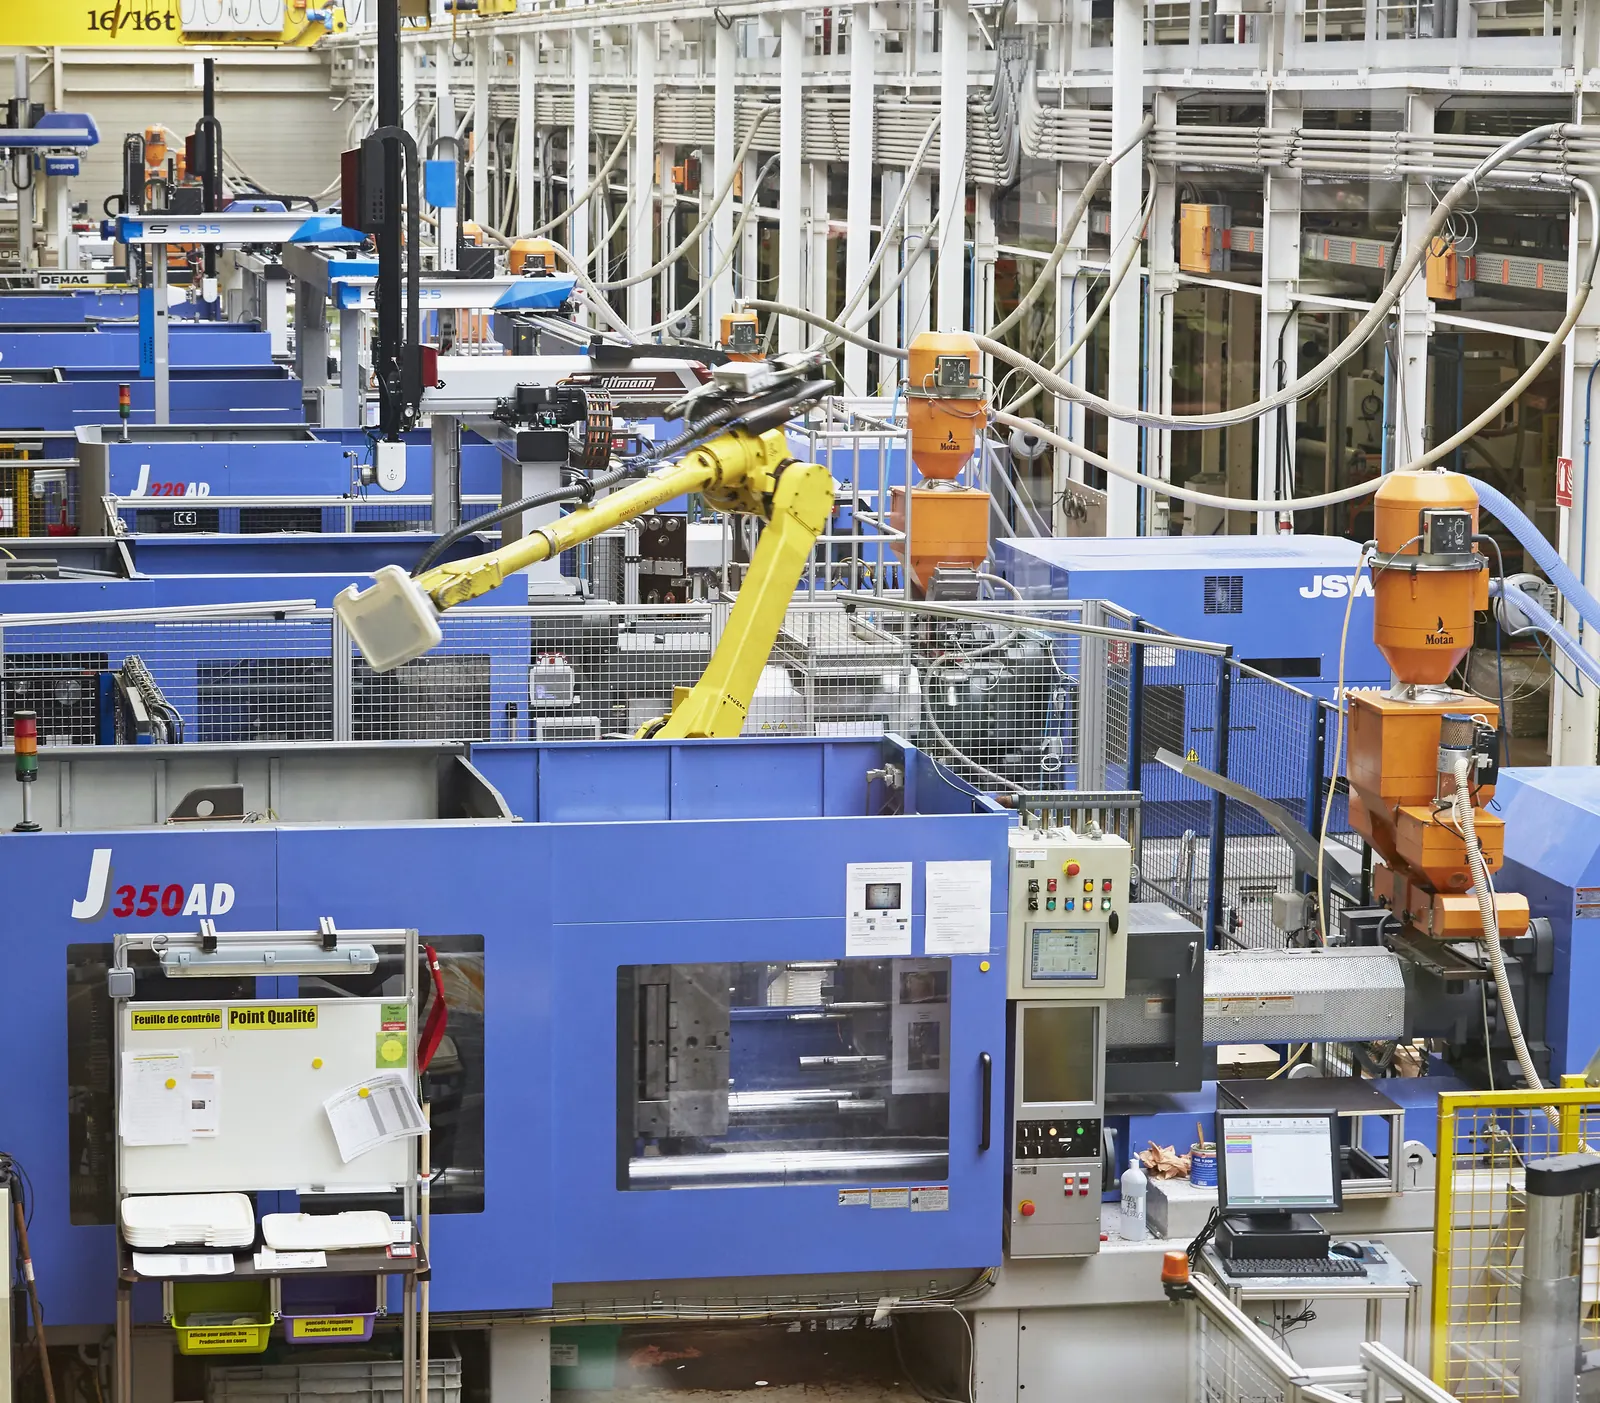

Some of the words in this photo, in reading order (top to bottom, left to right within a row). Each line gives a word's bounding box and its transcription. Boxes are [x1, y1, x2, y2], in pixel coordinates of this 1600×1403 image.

[50, 163, 76, 171] sepro
[148, 224, 169, 234] S
[179, 224, 221, 234] 5.35
[41, 276, 89, 284] DEMAG
[601, 376, 657, 388] ittmann
[940, 442, 960, 451] Motan
[1425, 634, 1454, 645] Motan
[134, 1014, 166, 1025] Feuille
[167, 1014, 179, 1024] de
[181, 1013, 220, 1024] contrôle
[230, 1010, 265, 1024] Point
[268, 1008, 316, 1025] Qualité
